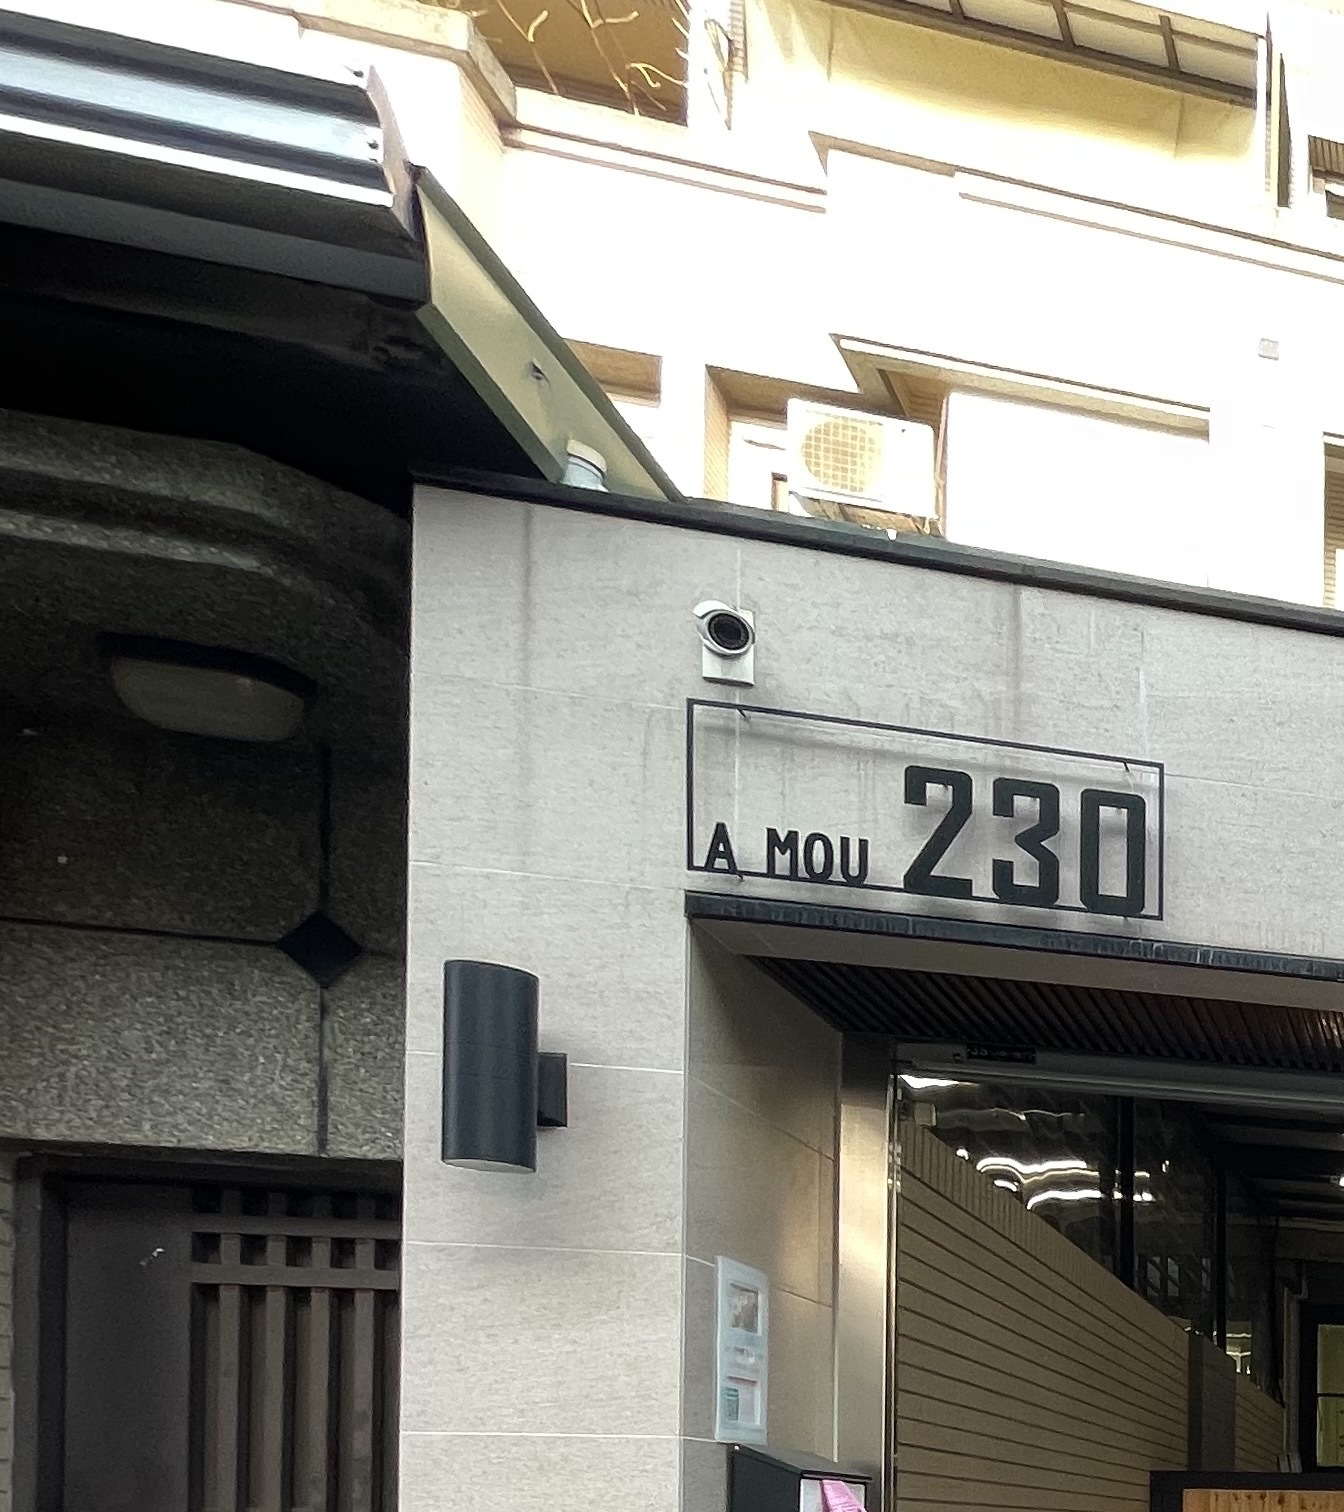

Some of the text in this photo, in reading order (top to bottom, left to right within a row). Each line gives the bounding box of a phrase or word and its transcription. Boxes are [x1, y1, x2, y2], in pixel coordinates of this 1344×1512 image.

[704, 765, 1147, 917] A MOU 230
